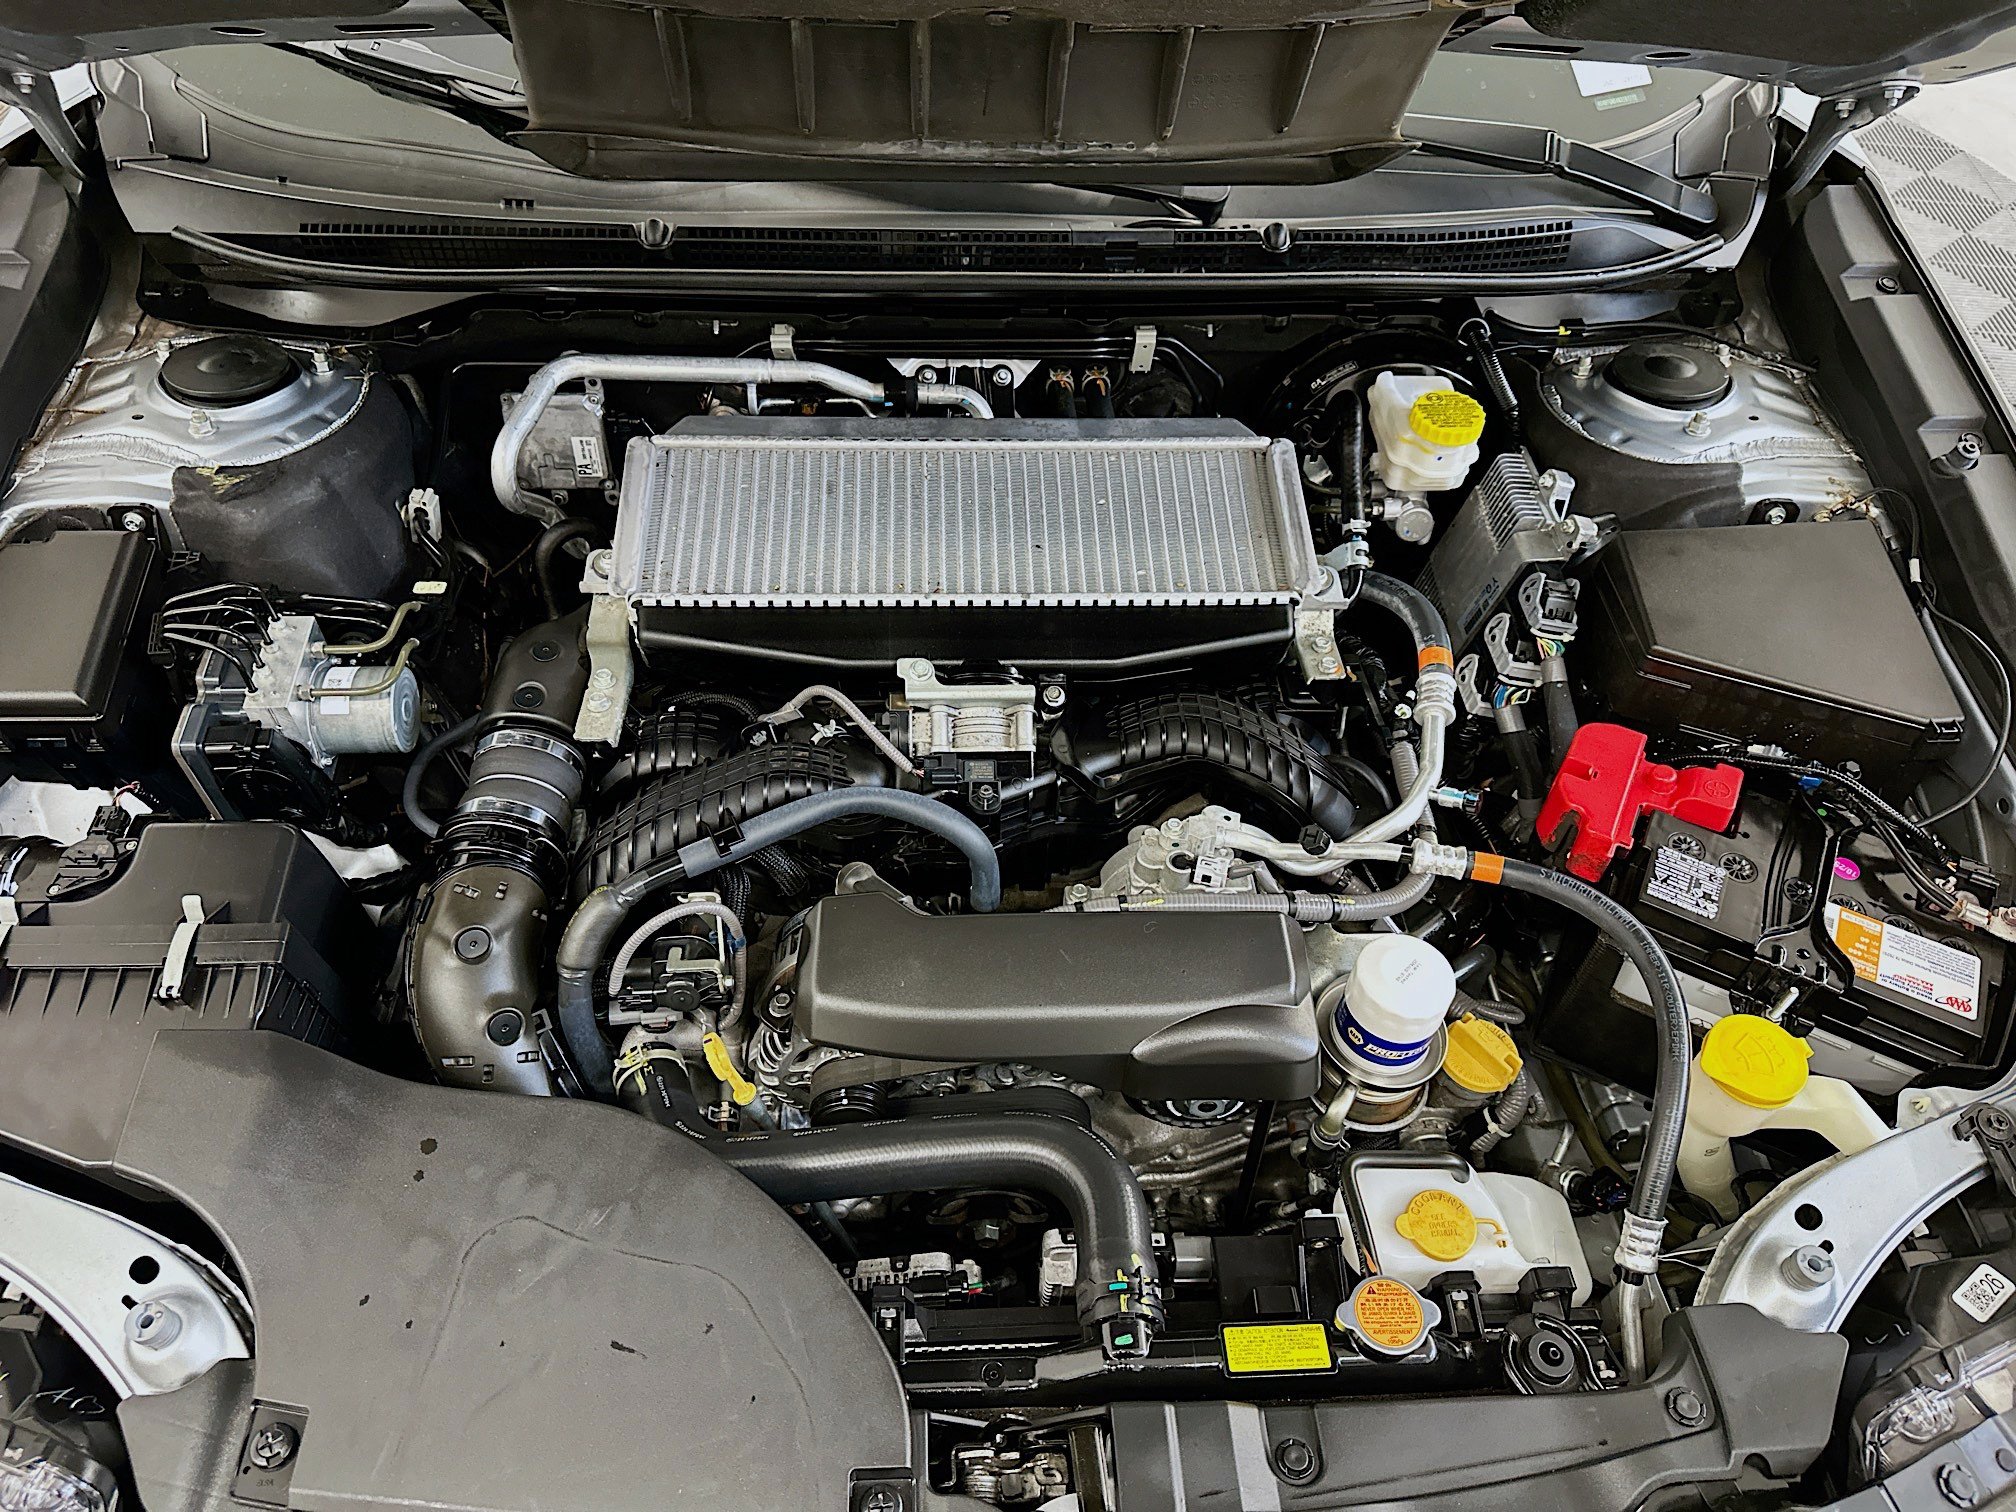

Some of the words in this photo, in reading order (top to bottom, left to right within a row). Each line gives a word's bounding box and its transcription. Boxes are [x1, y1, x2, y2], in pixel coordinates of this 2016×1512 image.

[577, 463, 593, 475] PA
[1946, 996, 1972, 1013] AAA
[1349, 1029, 1361, 1043] NAPA
[1411, 1192, 1464, 1215] COOLANT
[1979, 1273, 2005, 1296] 26
